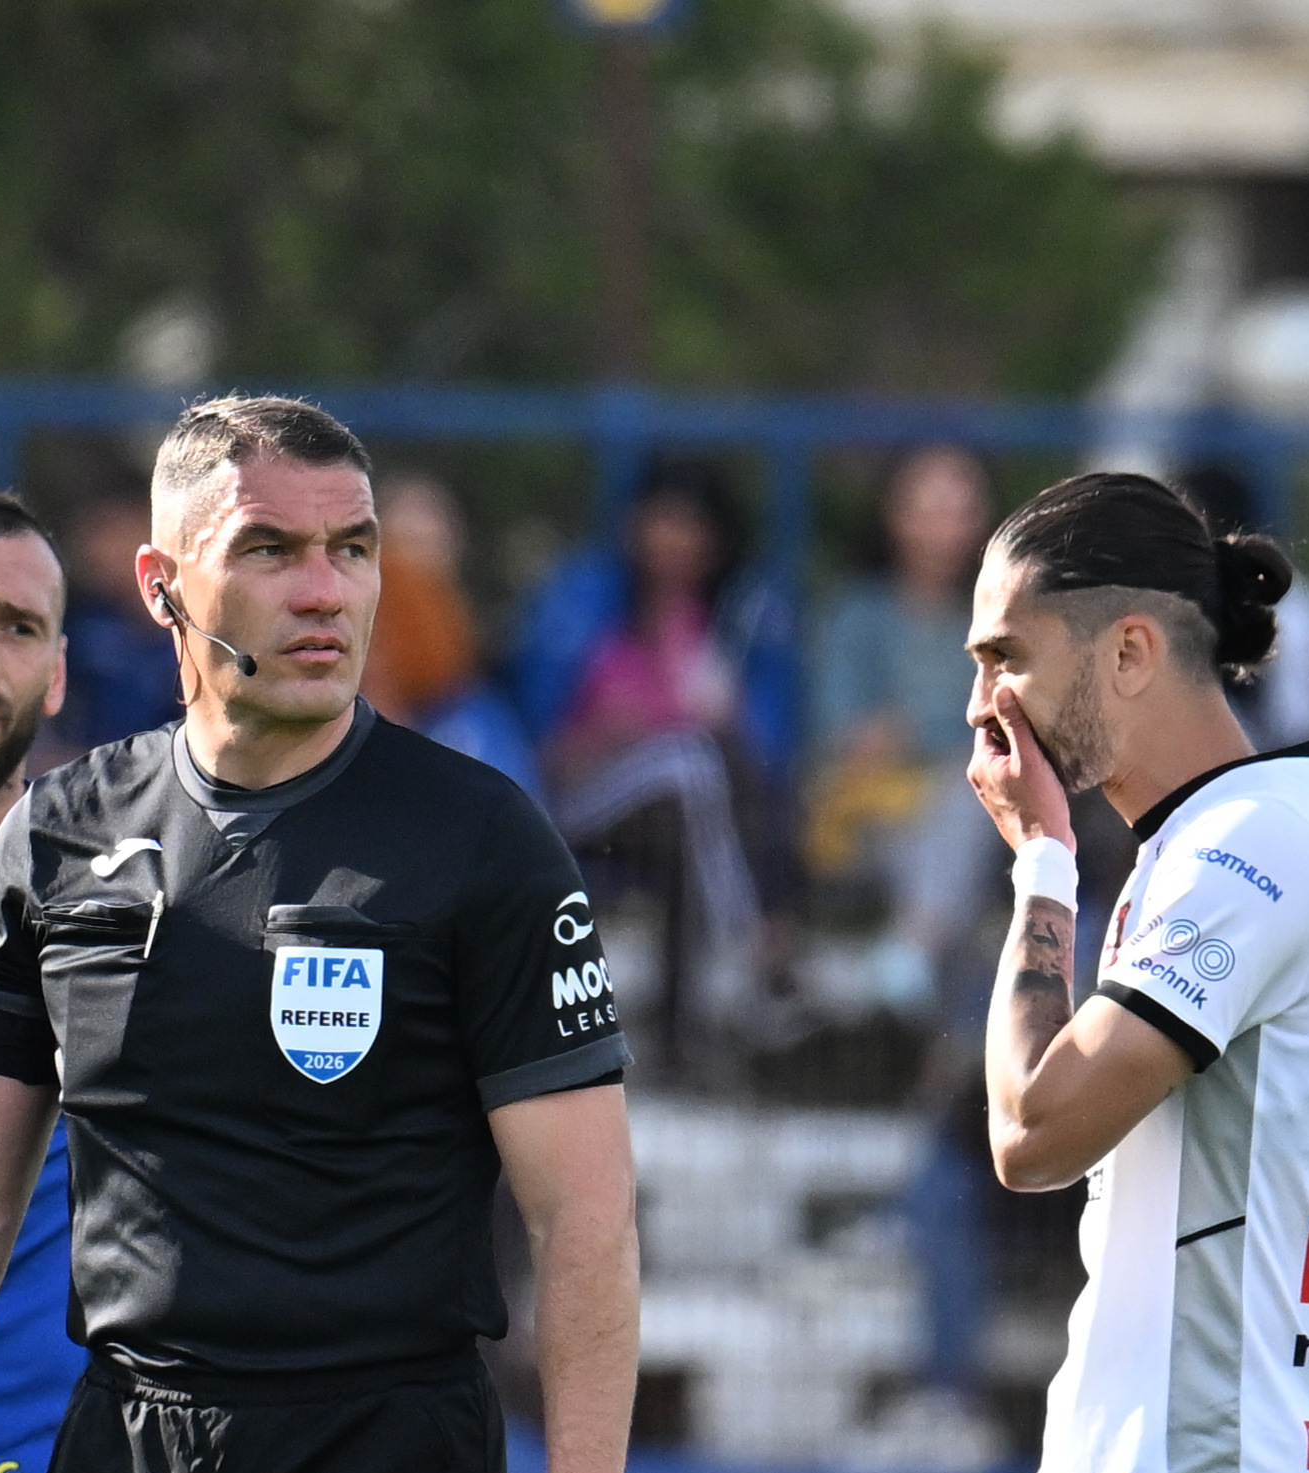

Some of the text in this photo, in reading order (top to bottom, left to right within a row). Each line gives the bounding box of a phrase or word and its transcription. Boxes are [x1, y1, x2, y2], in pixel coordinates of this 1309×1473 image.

[282, 956, 372, 990] FIFA
[280, 1009, 371, 1029] REFEREE
[303, 1053, 345, 1071] 2026
